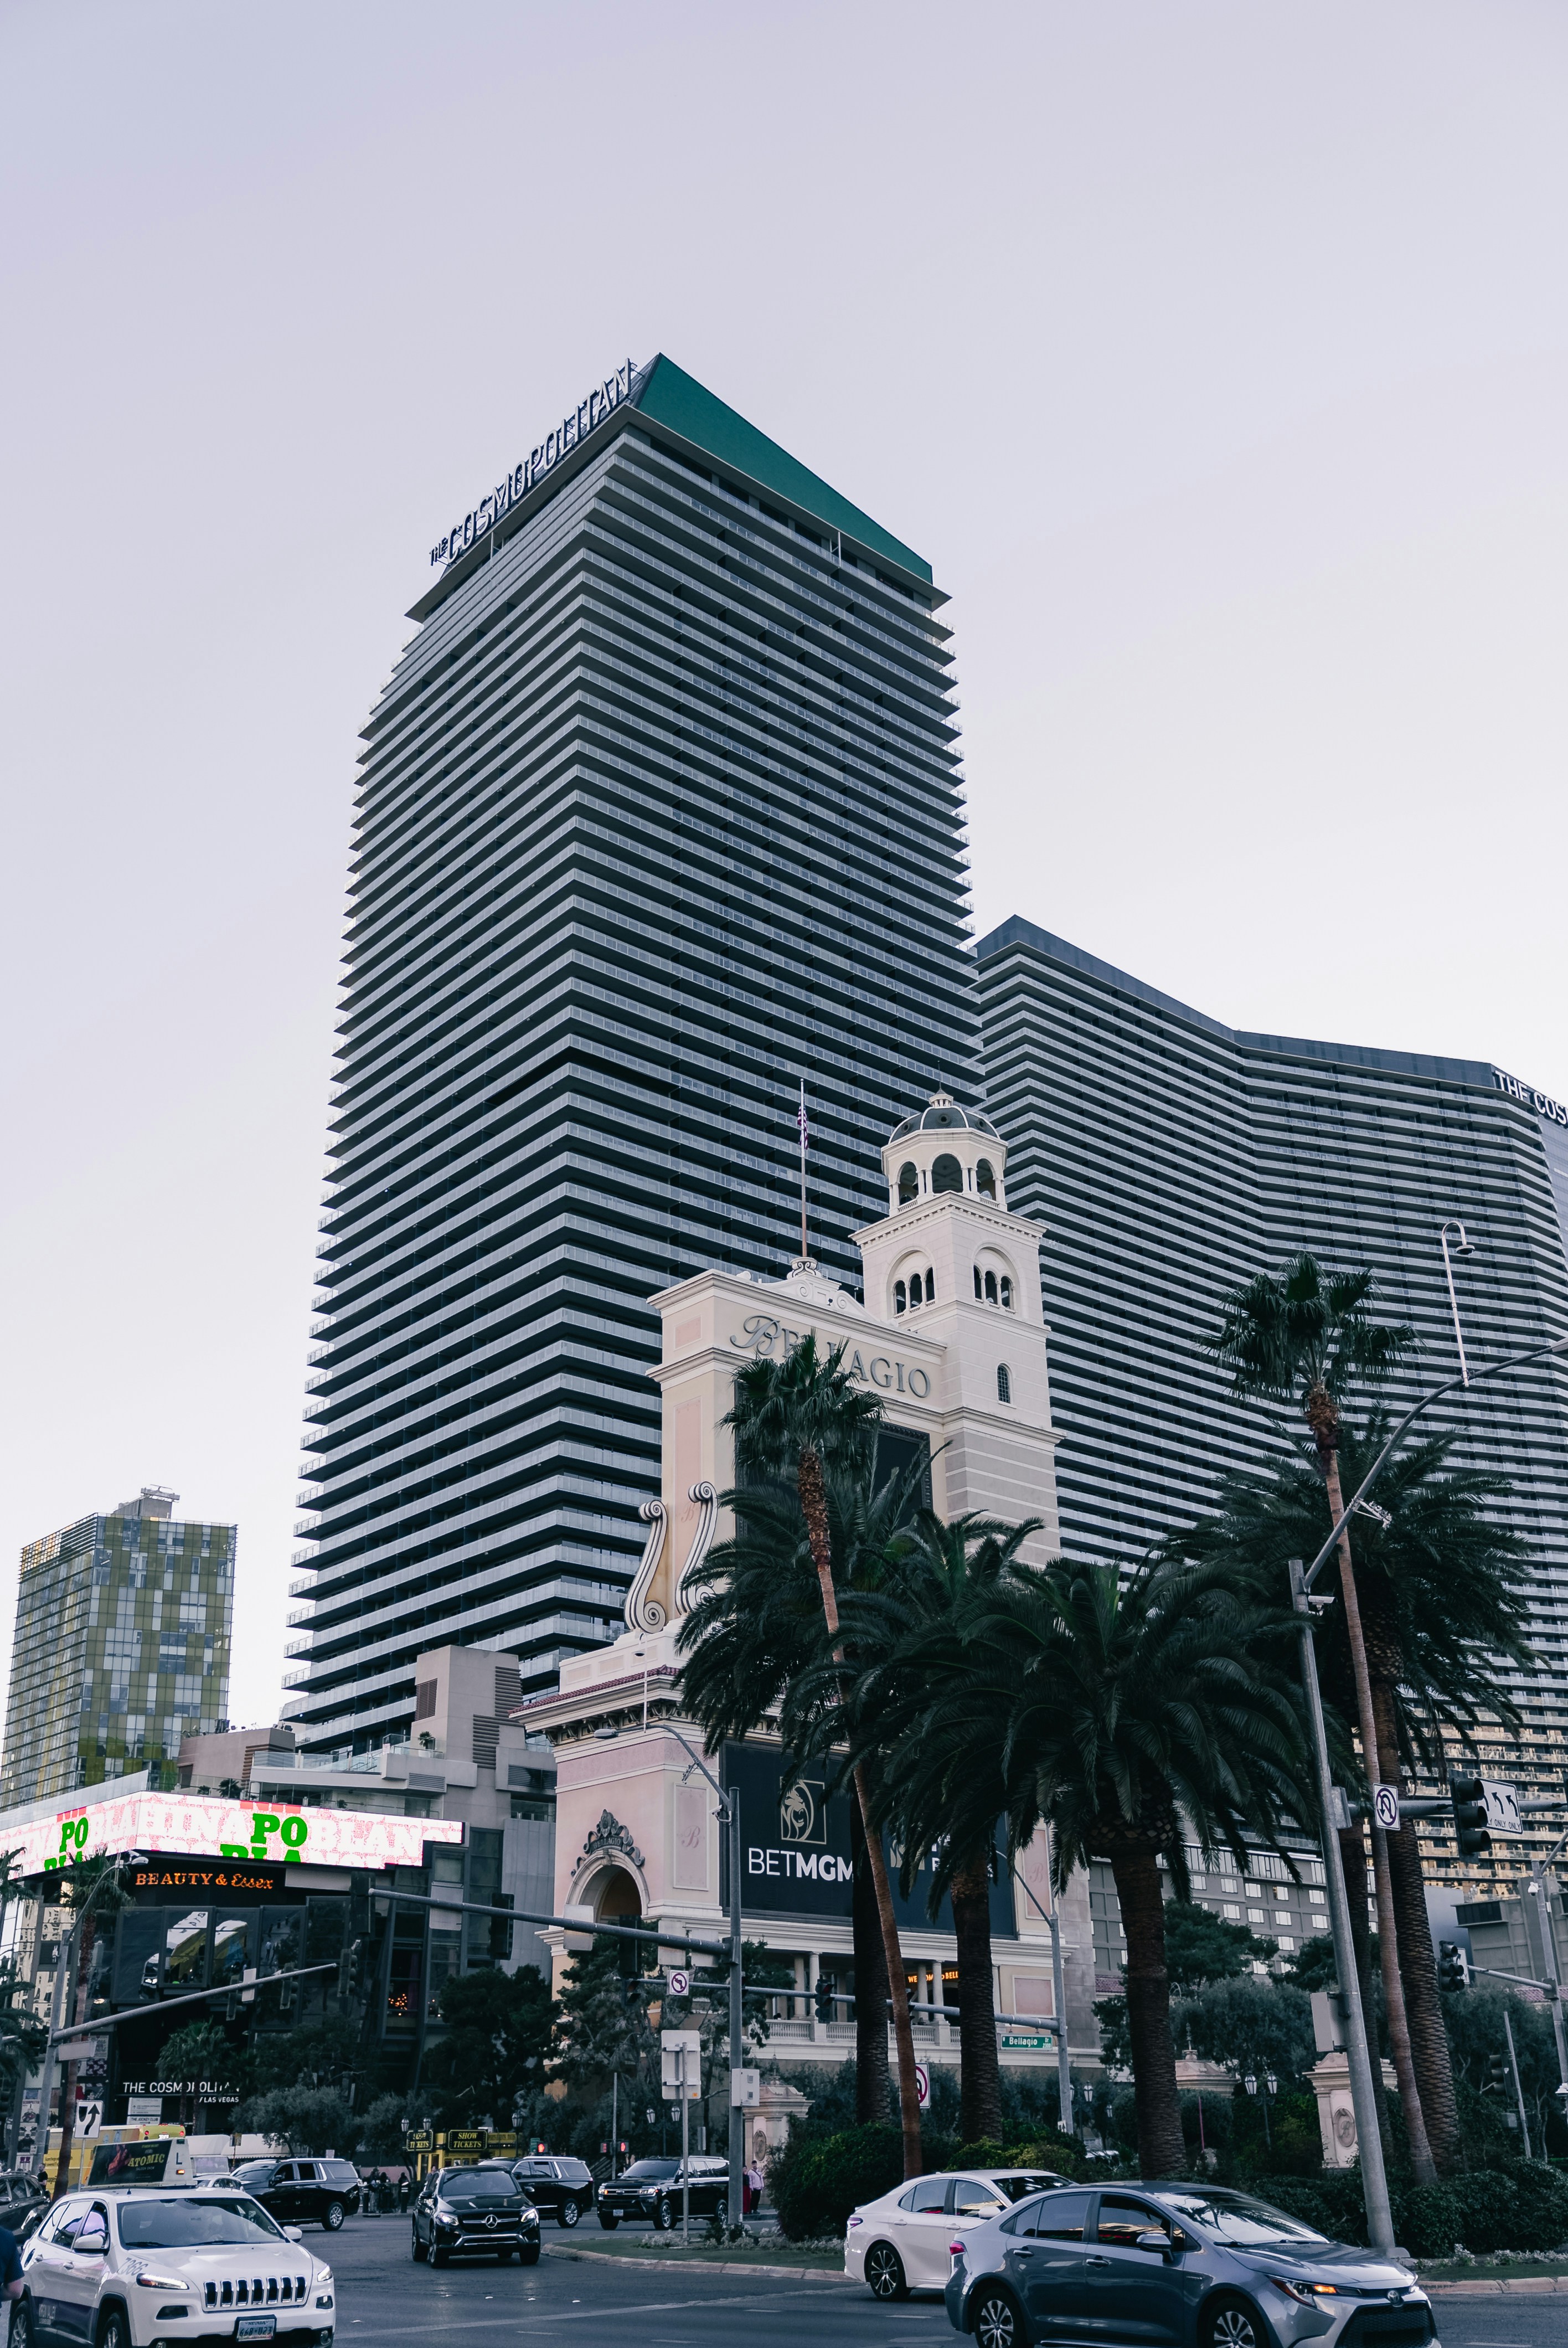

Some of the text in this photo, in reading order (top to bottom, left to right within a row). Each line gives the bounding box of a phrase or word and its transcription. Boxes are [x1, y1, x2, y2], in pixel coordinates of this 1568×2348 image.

[429, 358, 632, 566] THE COSMOPOLITAN
[1533, 1091, 1568, 1125] COS
[1494, 1819, 1506, 1828] ONLY
[1508, 1821, 1520, 1831] ONLY
[592, 1837, 621, 1850] BELLAGIO
[749, 1847, 853, 1882] BETMGM
[135, 1873, 273, 1889] BEAUTY & Essex
[1009, 2037, 1038, 2047] Bellagio
[123, 2082, 146, 2093] THE
[127, 2154, 165, 2167] ATOMIC
[117, 2257, 148, 2276] 7366
